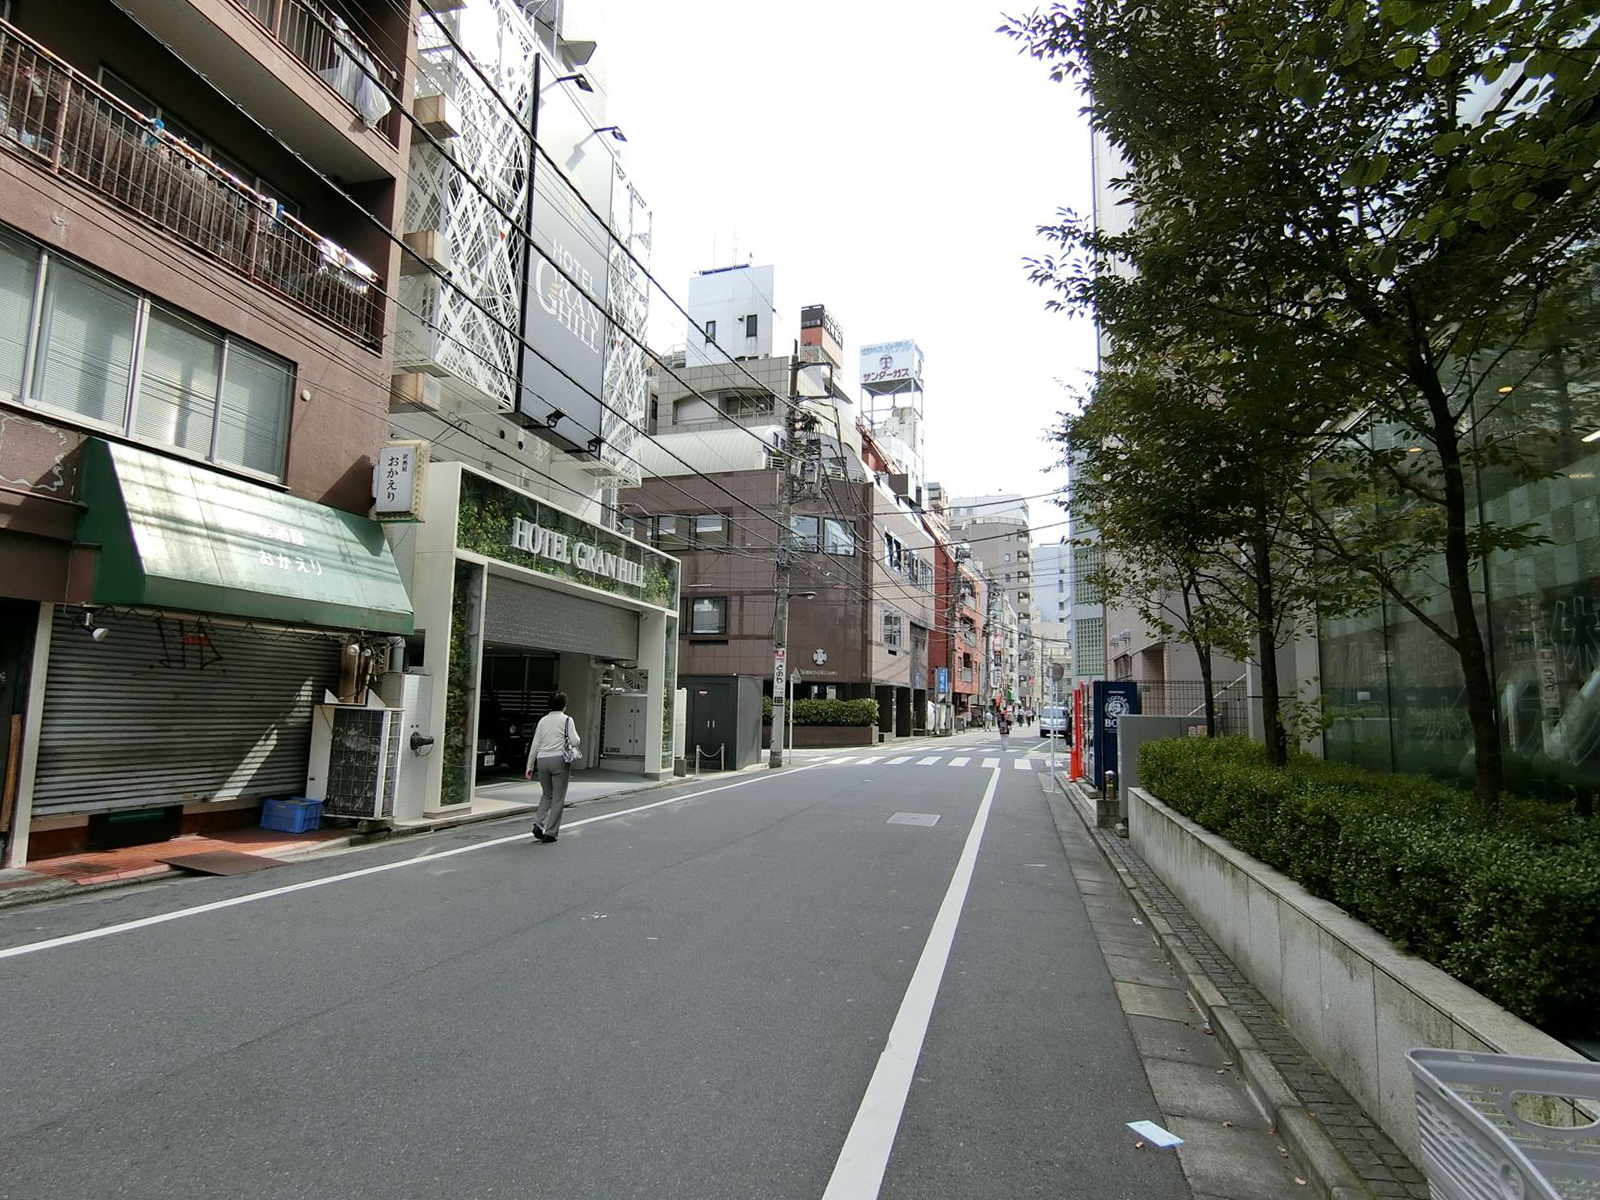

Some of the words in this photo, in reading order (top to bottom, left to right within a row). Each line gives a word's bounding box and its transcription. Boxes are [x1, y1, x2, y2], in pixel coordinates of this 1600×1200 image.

[535, 256, 601, 333] GRAN
[552, 237, 597, 298] HOTEL
[557, 297, 600, 354] HILL
[386, 455, 400, 503] おかえり
[258, 549, 323, 576] おかえり
[510, 516, 572, 564] HOTEL
[572, 541, 617, 580] GRAN
[615, 555, 647, 589] HILL
[1106, 695, 1128, 703] COFFEE
